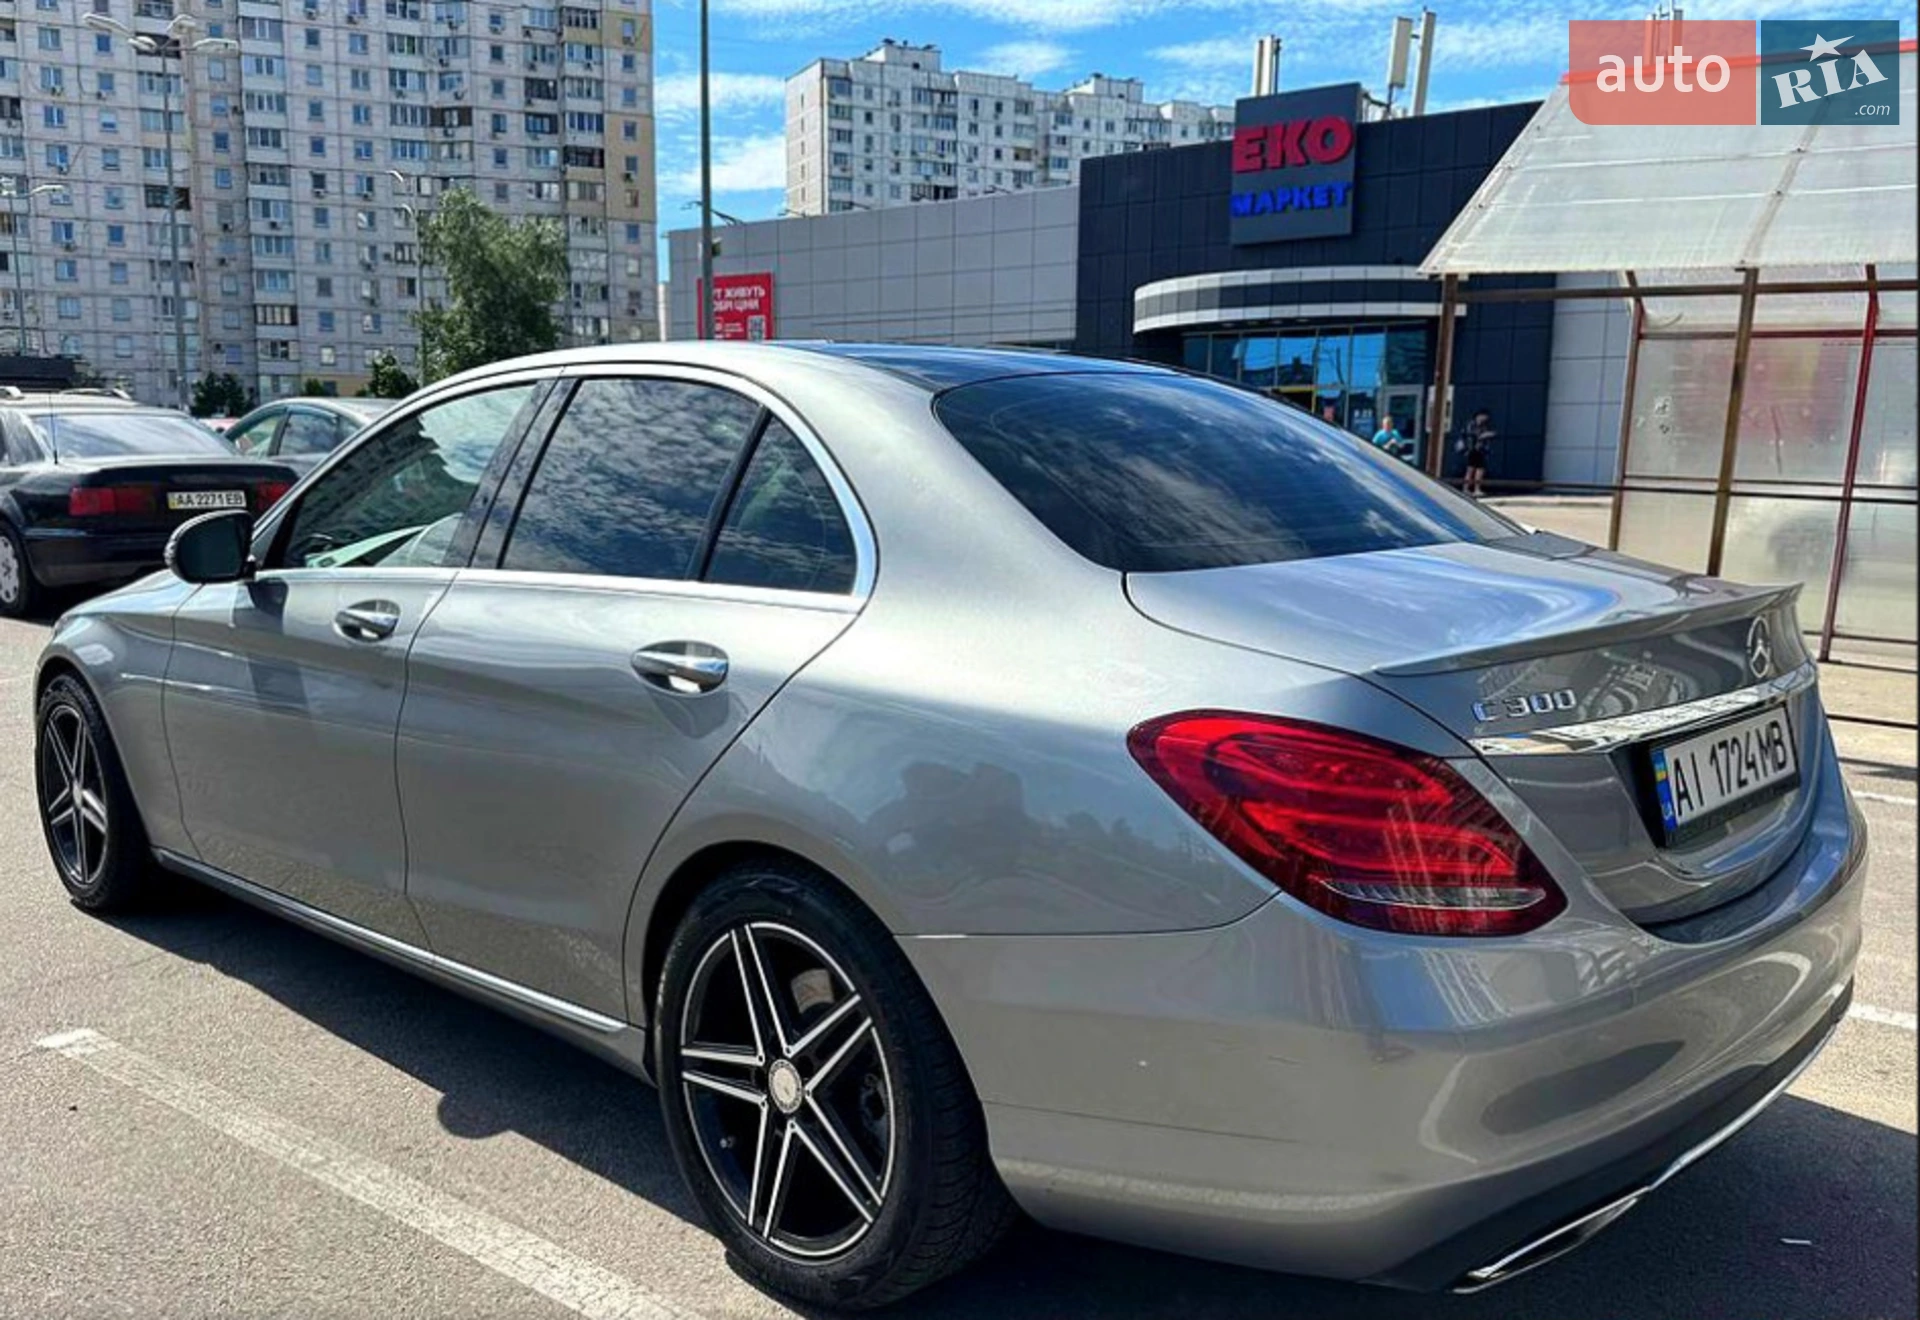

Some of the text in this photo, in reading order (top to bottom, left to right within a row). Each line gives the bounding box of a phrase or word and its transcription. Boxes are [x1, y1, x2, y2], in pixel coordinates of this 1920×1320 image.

[1231, 114, 1355, 174] ЕКО
[1230, 180, 1353, 218] МАРКЕТ
[1471, 687, 1577, 722] C 300
